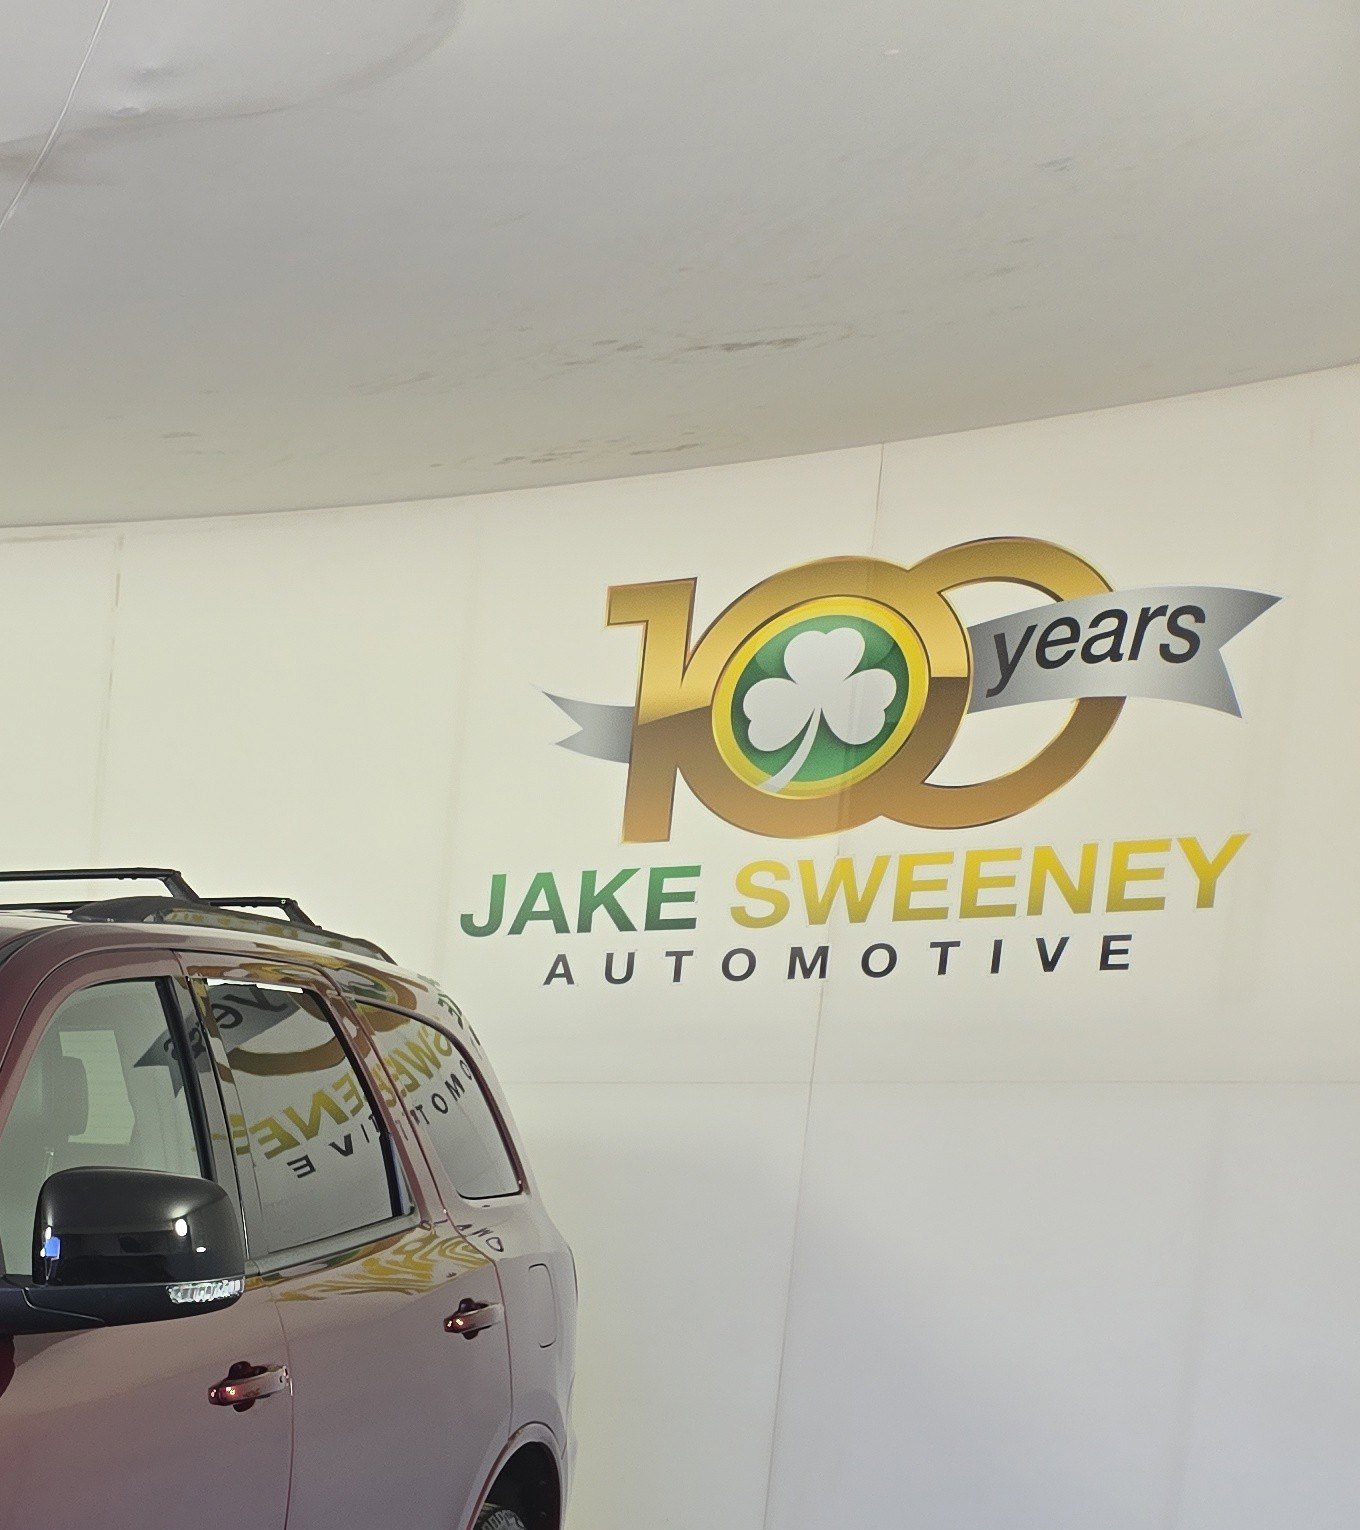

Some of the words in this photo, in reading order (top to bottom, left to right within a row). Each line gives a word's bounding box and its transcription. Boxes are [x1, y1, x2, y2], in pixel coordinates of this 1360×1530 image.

[603, 535, 1127, 844] 100
[984, 603, 1206, 700] years
[460, 865, 702, 938] JAKE
[729, 833, 1250, 930] SWEENEY
[543, 933, 1134, 988] AUTOMOTIVE
